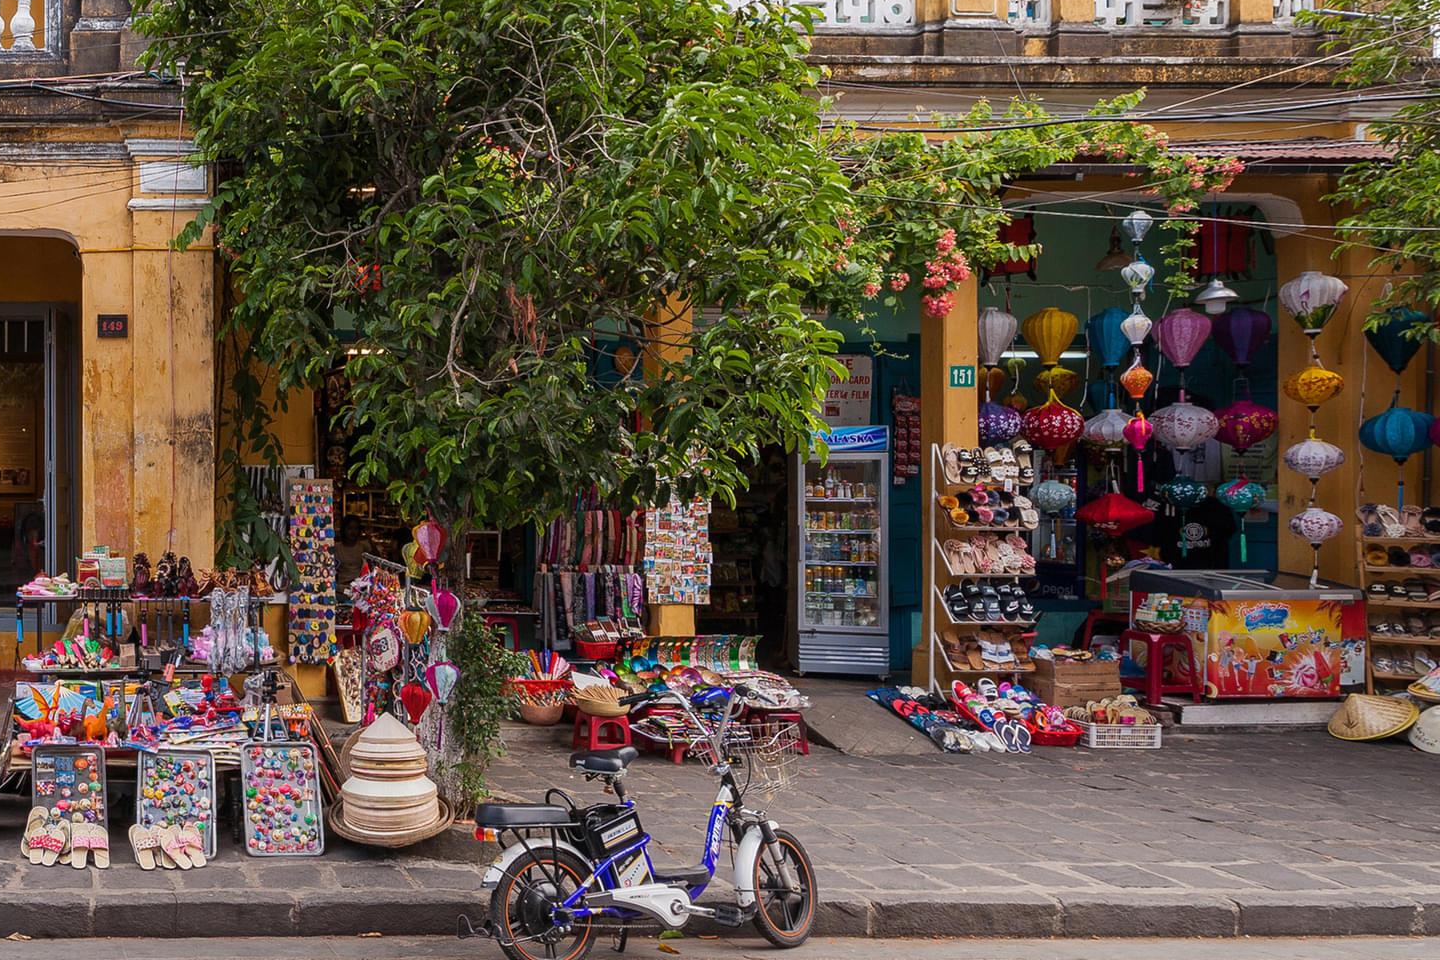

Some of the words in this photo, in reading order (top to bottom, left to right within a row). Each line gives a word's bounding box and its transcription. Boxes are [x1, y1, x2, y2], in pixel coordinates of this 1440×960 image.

[849, 375, 870, 385] CARD
[952, 369, 972, 385] 151
[851, 391, 869, 400] FILM
[825, 434, 874, 444] ALASKA
